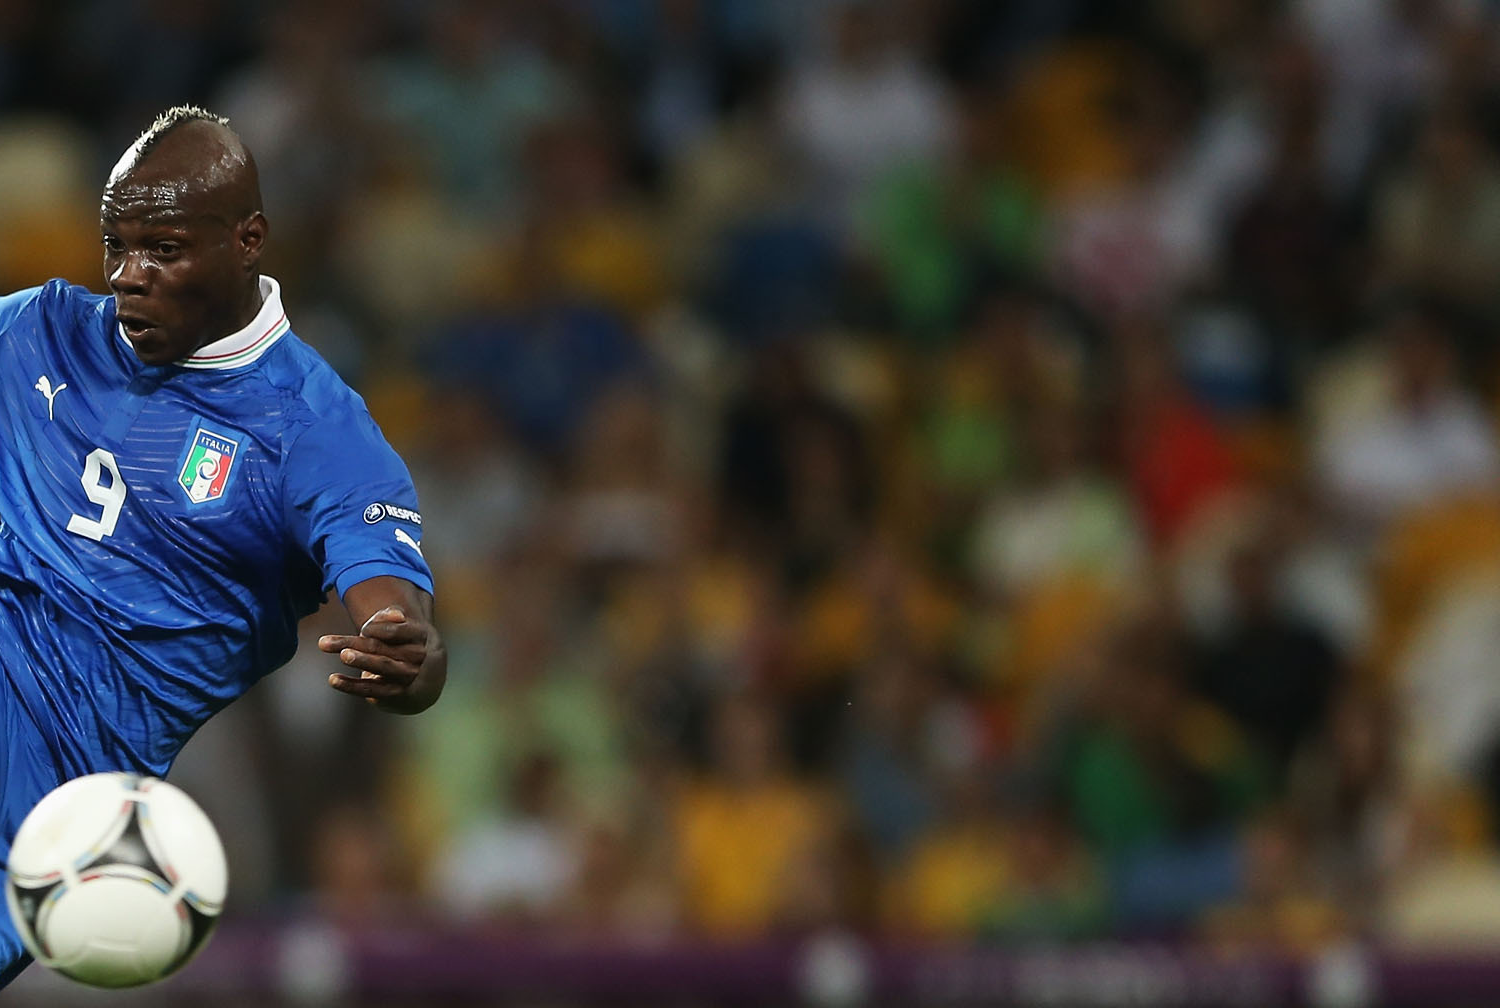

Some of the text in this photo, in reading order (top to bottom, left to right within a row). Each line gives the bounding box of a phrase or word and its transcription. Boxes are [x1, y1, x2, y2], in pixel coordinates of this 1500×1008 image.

[201, 436, 230, 455] ITALIA
[66, 447, 127, 542] 9
[385, 504, 421, 524] RESPEC
